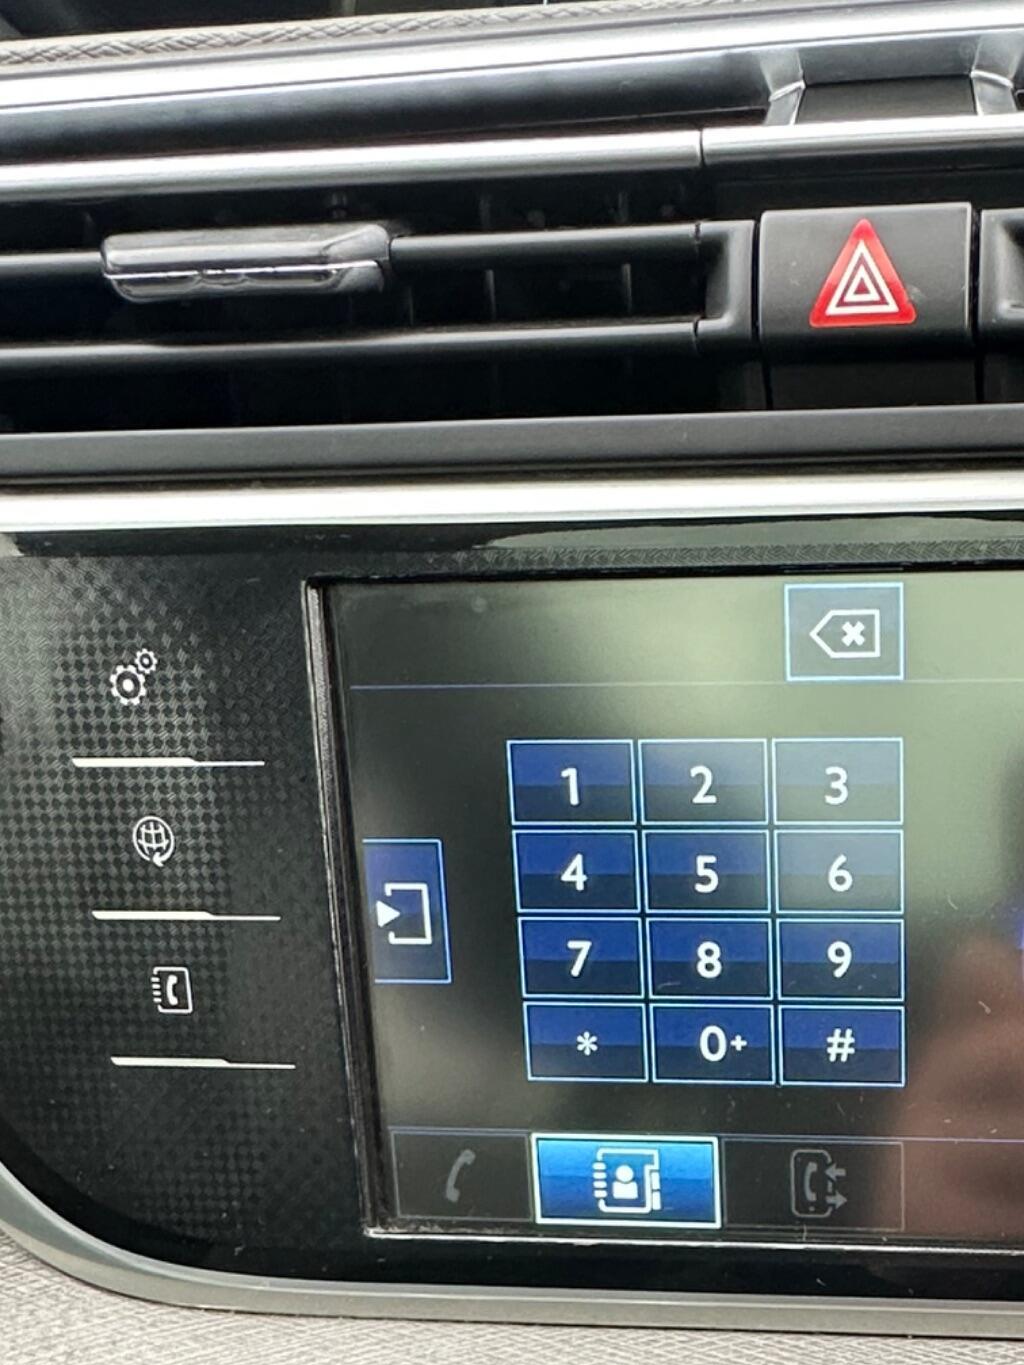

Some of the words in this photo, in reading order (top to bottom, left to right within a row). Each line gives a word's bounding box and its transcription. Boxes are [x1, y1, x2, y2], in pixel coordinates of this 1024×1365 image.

[560, 767, 580, 806] 1
[689, 765, 717, 804] 2
[824, 766, 849, 805] 3
[560, 853, 588, 891] 4
[693, 854, 719, 893] 5
[827, 854, 853, 892] 6
[566, 940, 592, 978] 7
[696, 941, 723, 979] 8
[827, 941, 853, 978] 9
